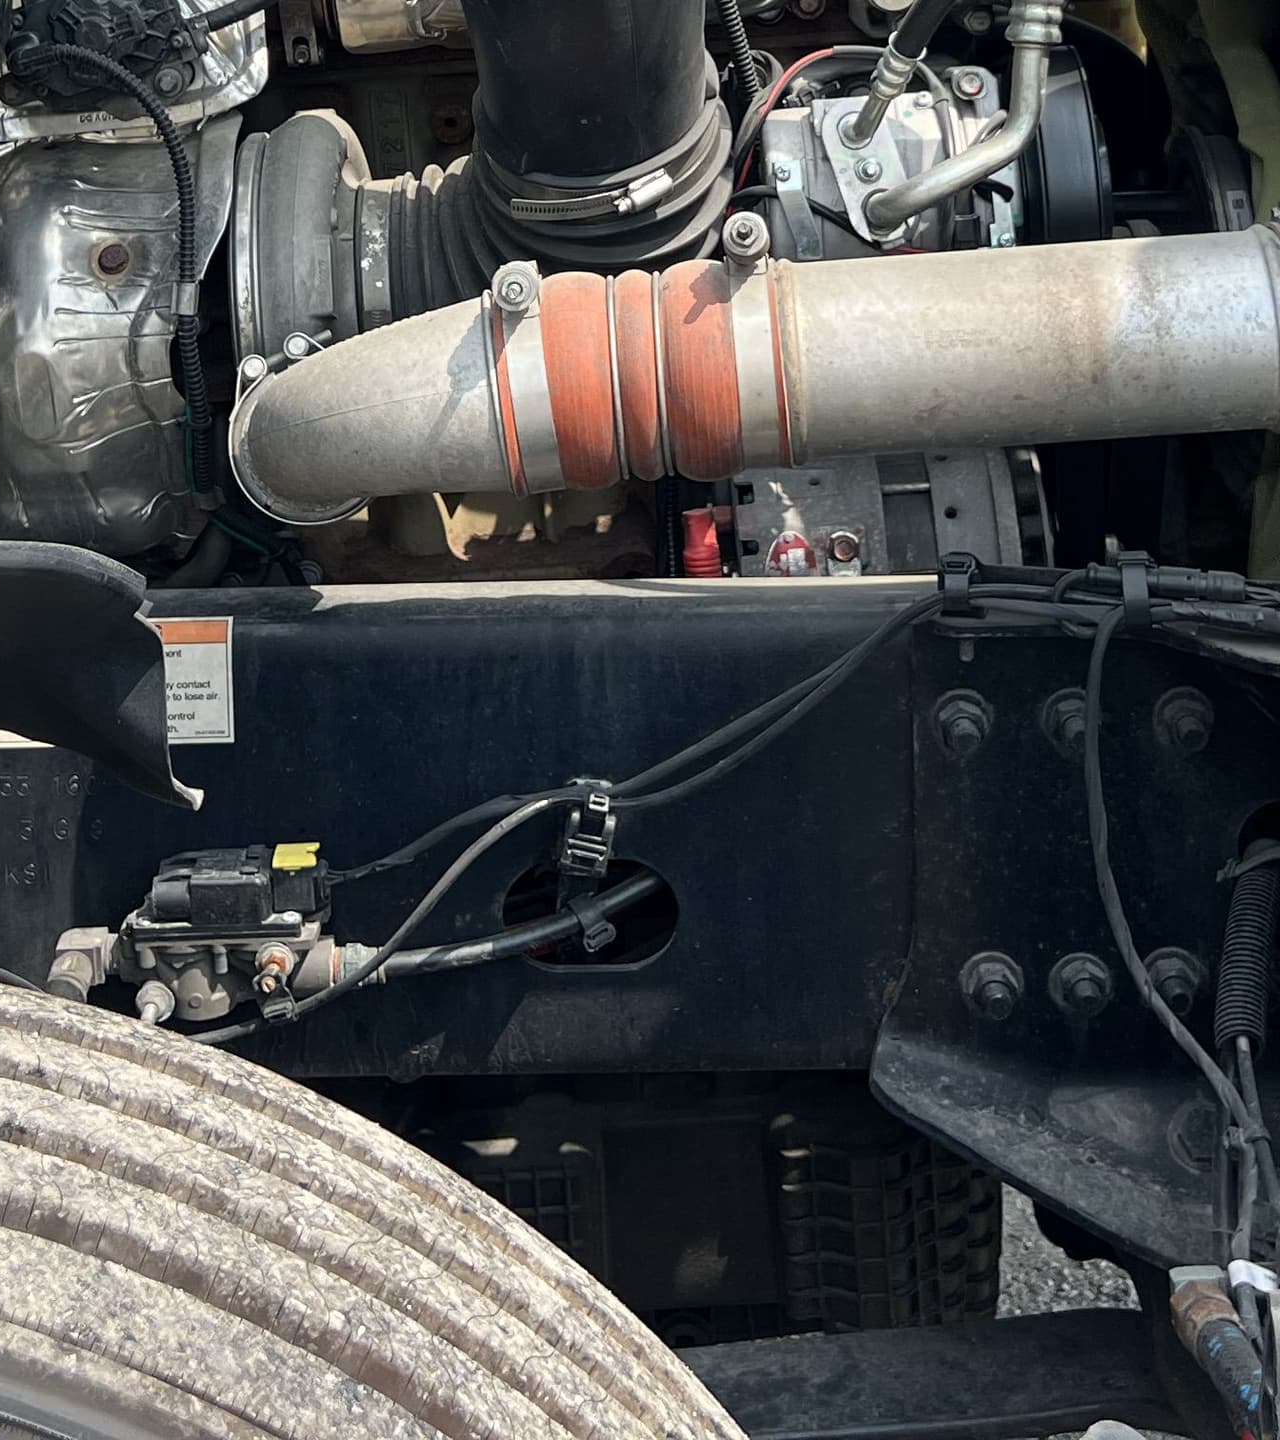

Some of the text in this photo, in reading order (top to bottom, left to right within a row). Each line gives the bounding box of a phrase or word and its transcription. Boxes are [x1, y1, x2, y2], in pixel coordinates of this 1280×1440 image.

[176, 680, 211, 689] contact
[172, 693, 182, 701] to
[184, 692, 205, 700] lose
[167, 712, 196, 720] ontrol
